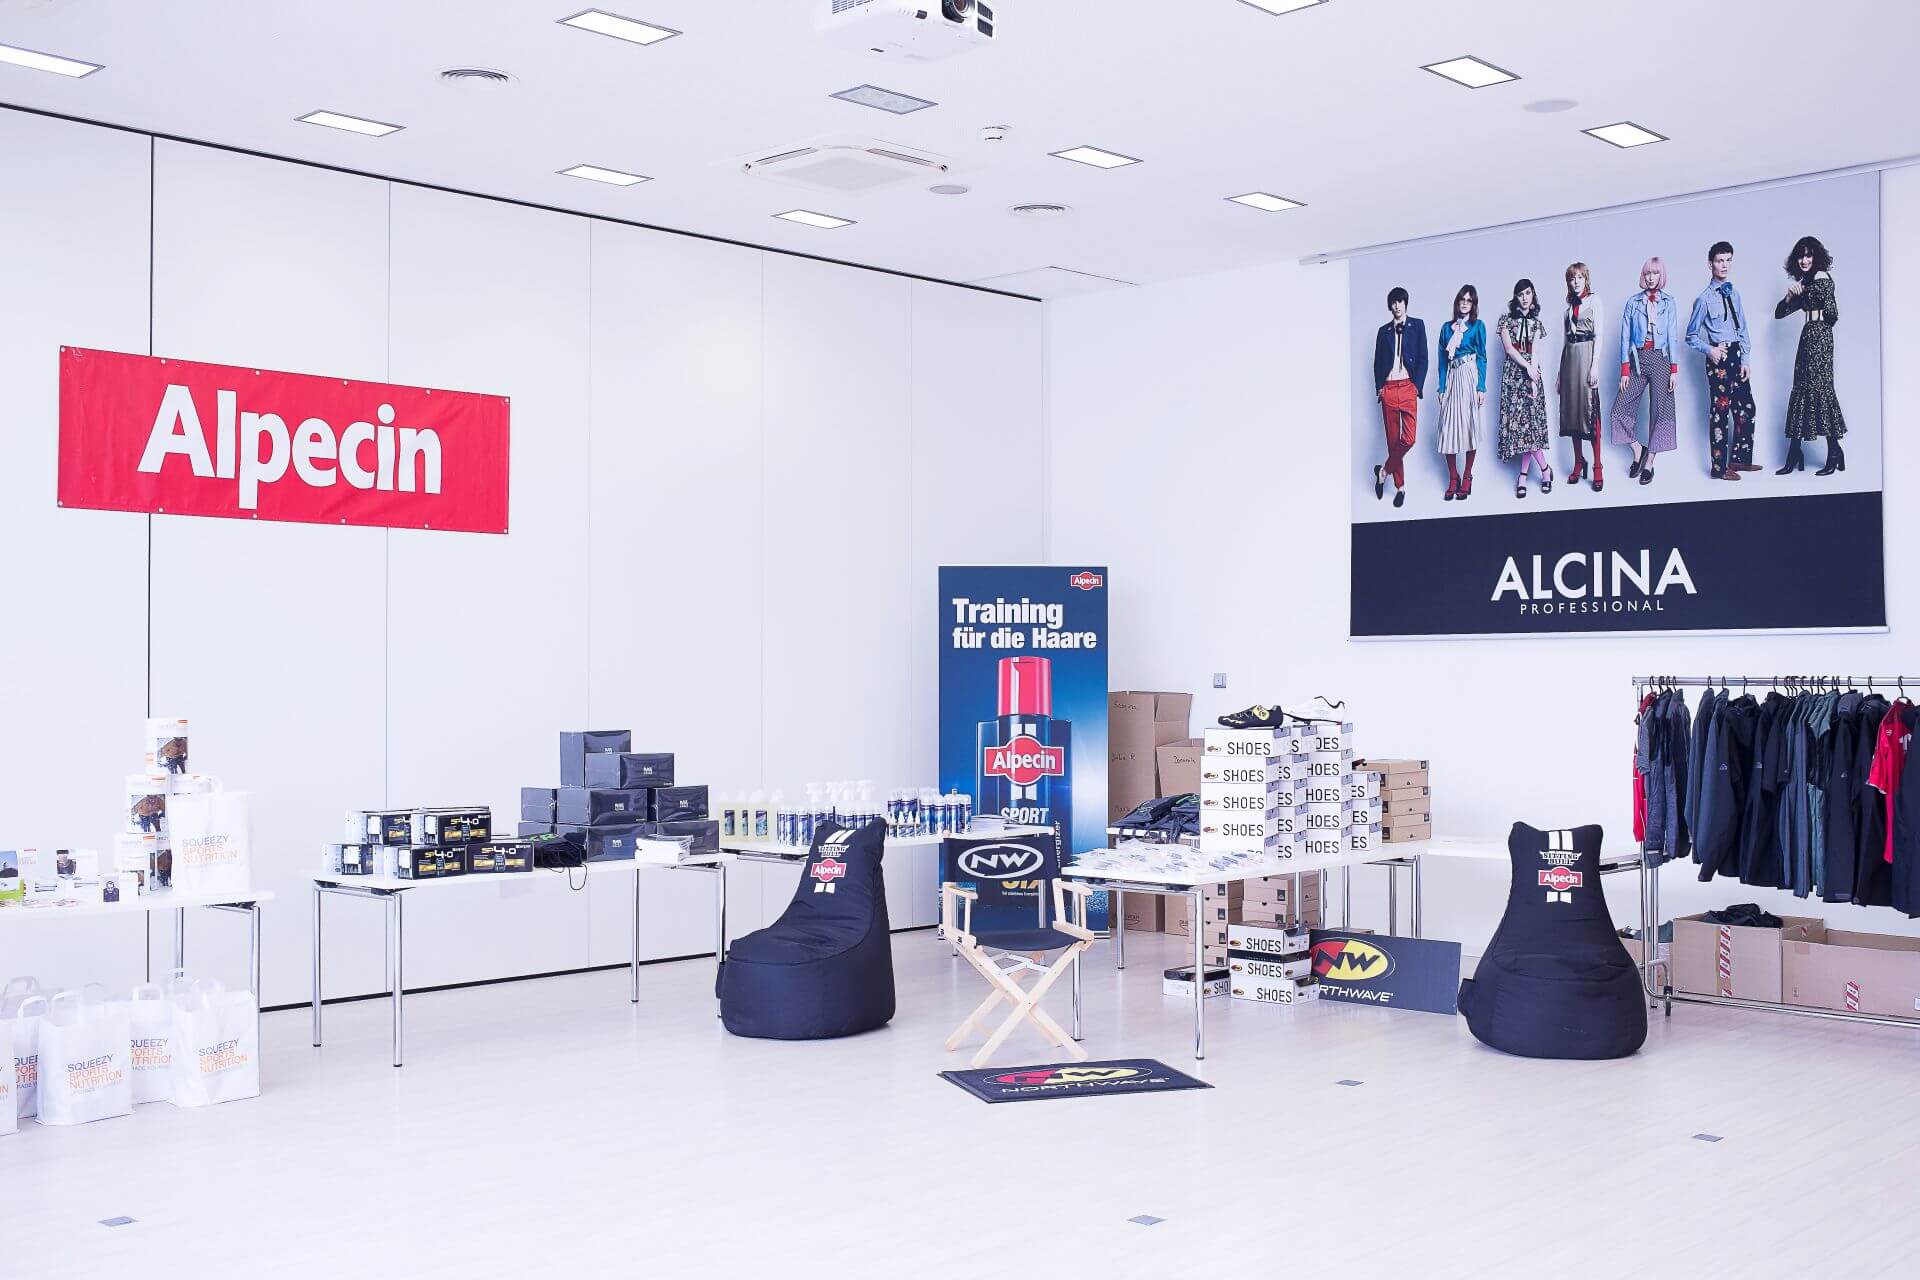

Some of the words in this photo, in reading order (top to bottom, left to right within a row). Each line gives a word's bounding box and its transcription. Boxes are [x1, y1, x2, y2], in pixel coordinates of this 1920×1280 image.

[136, 383, 443, 511] Alpecin
[1074, 575, 1099, 587] Alpecin
[1490, 547, 1697, 602] ALCINA
[952, 597, 1064, 629] Training
[1520, 599, 1664, 615] PROFESSIONAL
[952, 627, 986, 649] für
[990, 627, 1025, 649] die
[1032, 628, 1097, 649] Haare
[1227, 742, 1271, 756] SHOES
[991, 750, 1056, 770] Alpecin
[1223, 769, 1265, 783] SHOES
[1307, 763, 1340, 777] HOES
[1223, 796, 1265, 810] SHOES
[1306, 788, 1340, 803] HOES
[1001, 807, 1050, 826] SPORT
[1306, 815, 1340, 829] HOES
[1222, 823, 1264, 837] SHOES
[182, 834, 230, 848] SQUEEZY
[1305, 840, 1340, 854] HOES
[970, 852, 1031, 869] NW
[1543, 873, 1578, 884] Alpecin
[1246, 937, 1282, 953] SHOES
[1315, 949, 1380, 972] NW
[1247, 962, 1282, 978] SHOES
[1214, 979, 1230, 995] SHO
[1320, 984, 1391, 1002] RTHWAVE
[1256, 987, 1292, 1004] SHOES
[199, 1038, 240, 1057] SQUEEZY
[67, 1054, 114, 1073] SQUEEZY
[1002, 1077, 1170, 1093] NORTHWAVE
